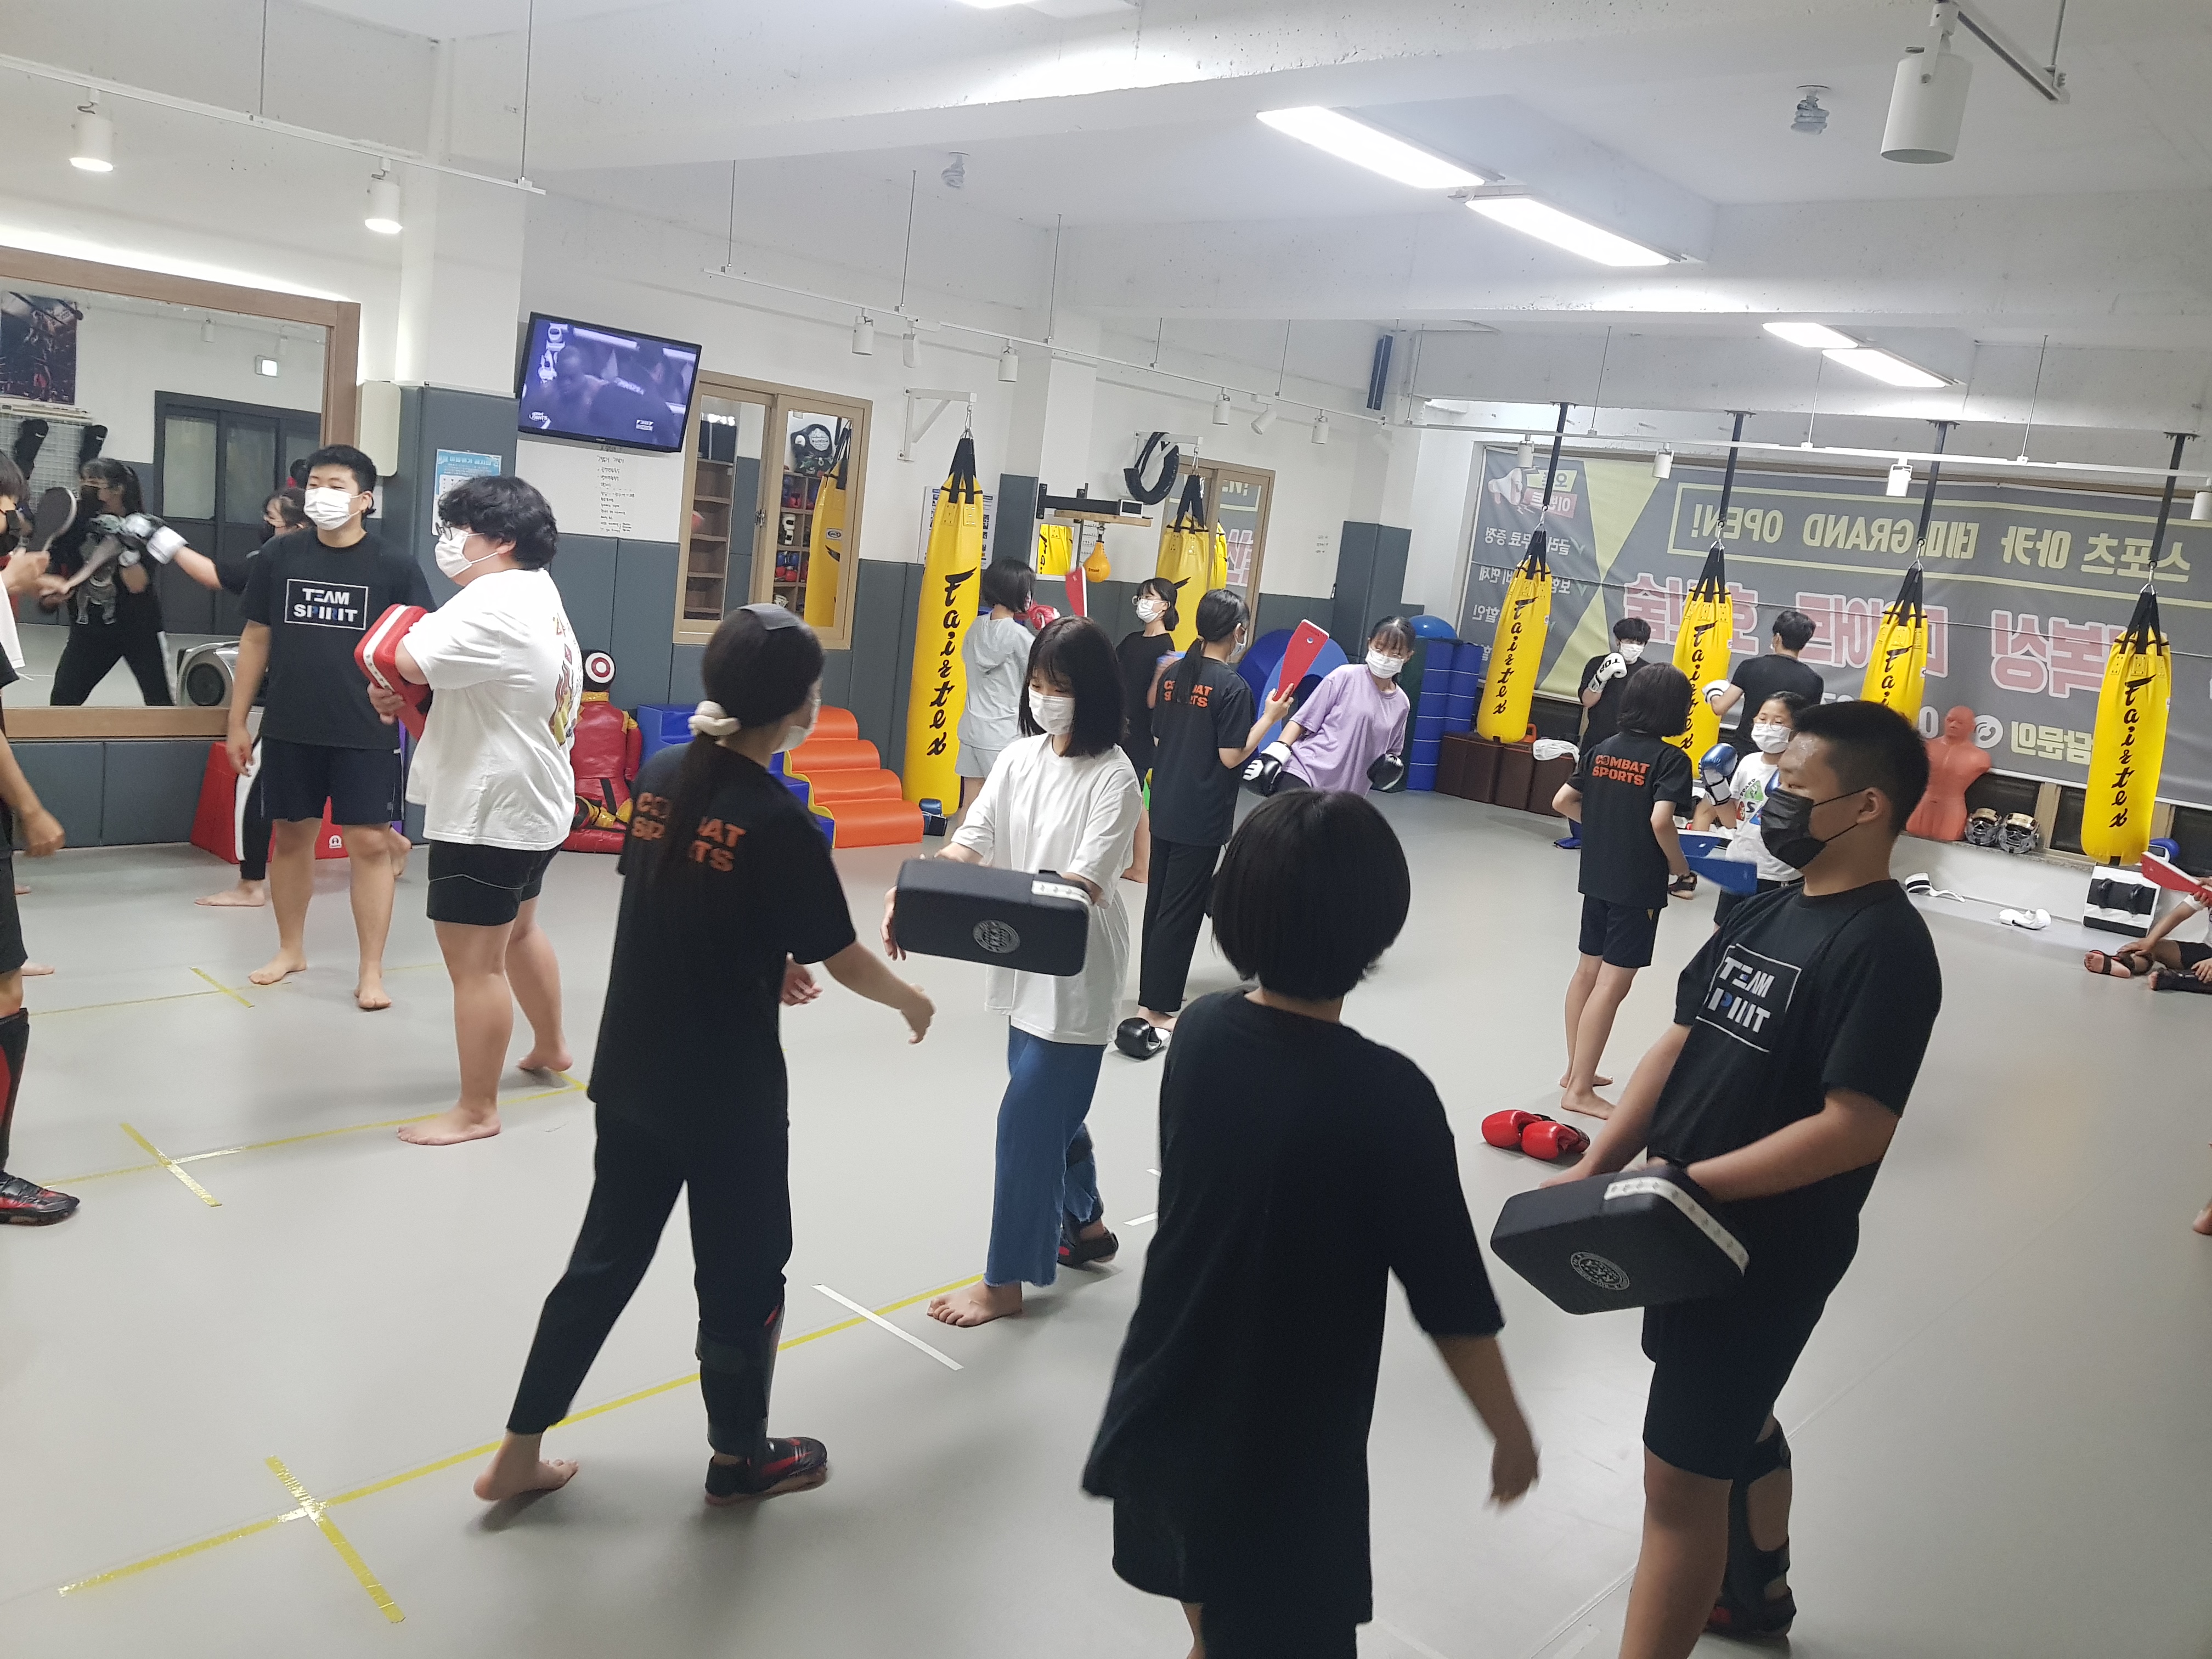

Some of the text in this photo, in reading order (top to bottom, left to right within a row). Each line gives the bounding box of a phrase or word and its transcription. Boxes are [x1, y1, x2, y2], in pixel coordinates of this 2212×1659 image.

[294, 604, 358, 622] SPIRIT
[302, 588, 350, 605] TEAM
[926, 567, 977, 757] Fairtex
[1493, 596, 1539, 715] Fairtex
[1164, 680, 1214, 697] CAT
[1164, 691, 1208, 708] STS
[1595, 754, 1651, 775] COMBAT
[2108, 674, 2157, 828] Fairtex
[1592, 765, 1645, 786] SPORTS
[636, 792, 747, 848] COAT
[631, 815, 735, 872] SPTS
[1719, 956, 1775, 998] TEAM
[1707, 987, 1771, 1034] PIIT
